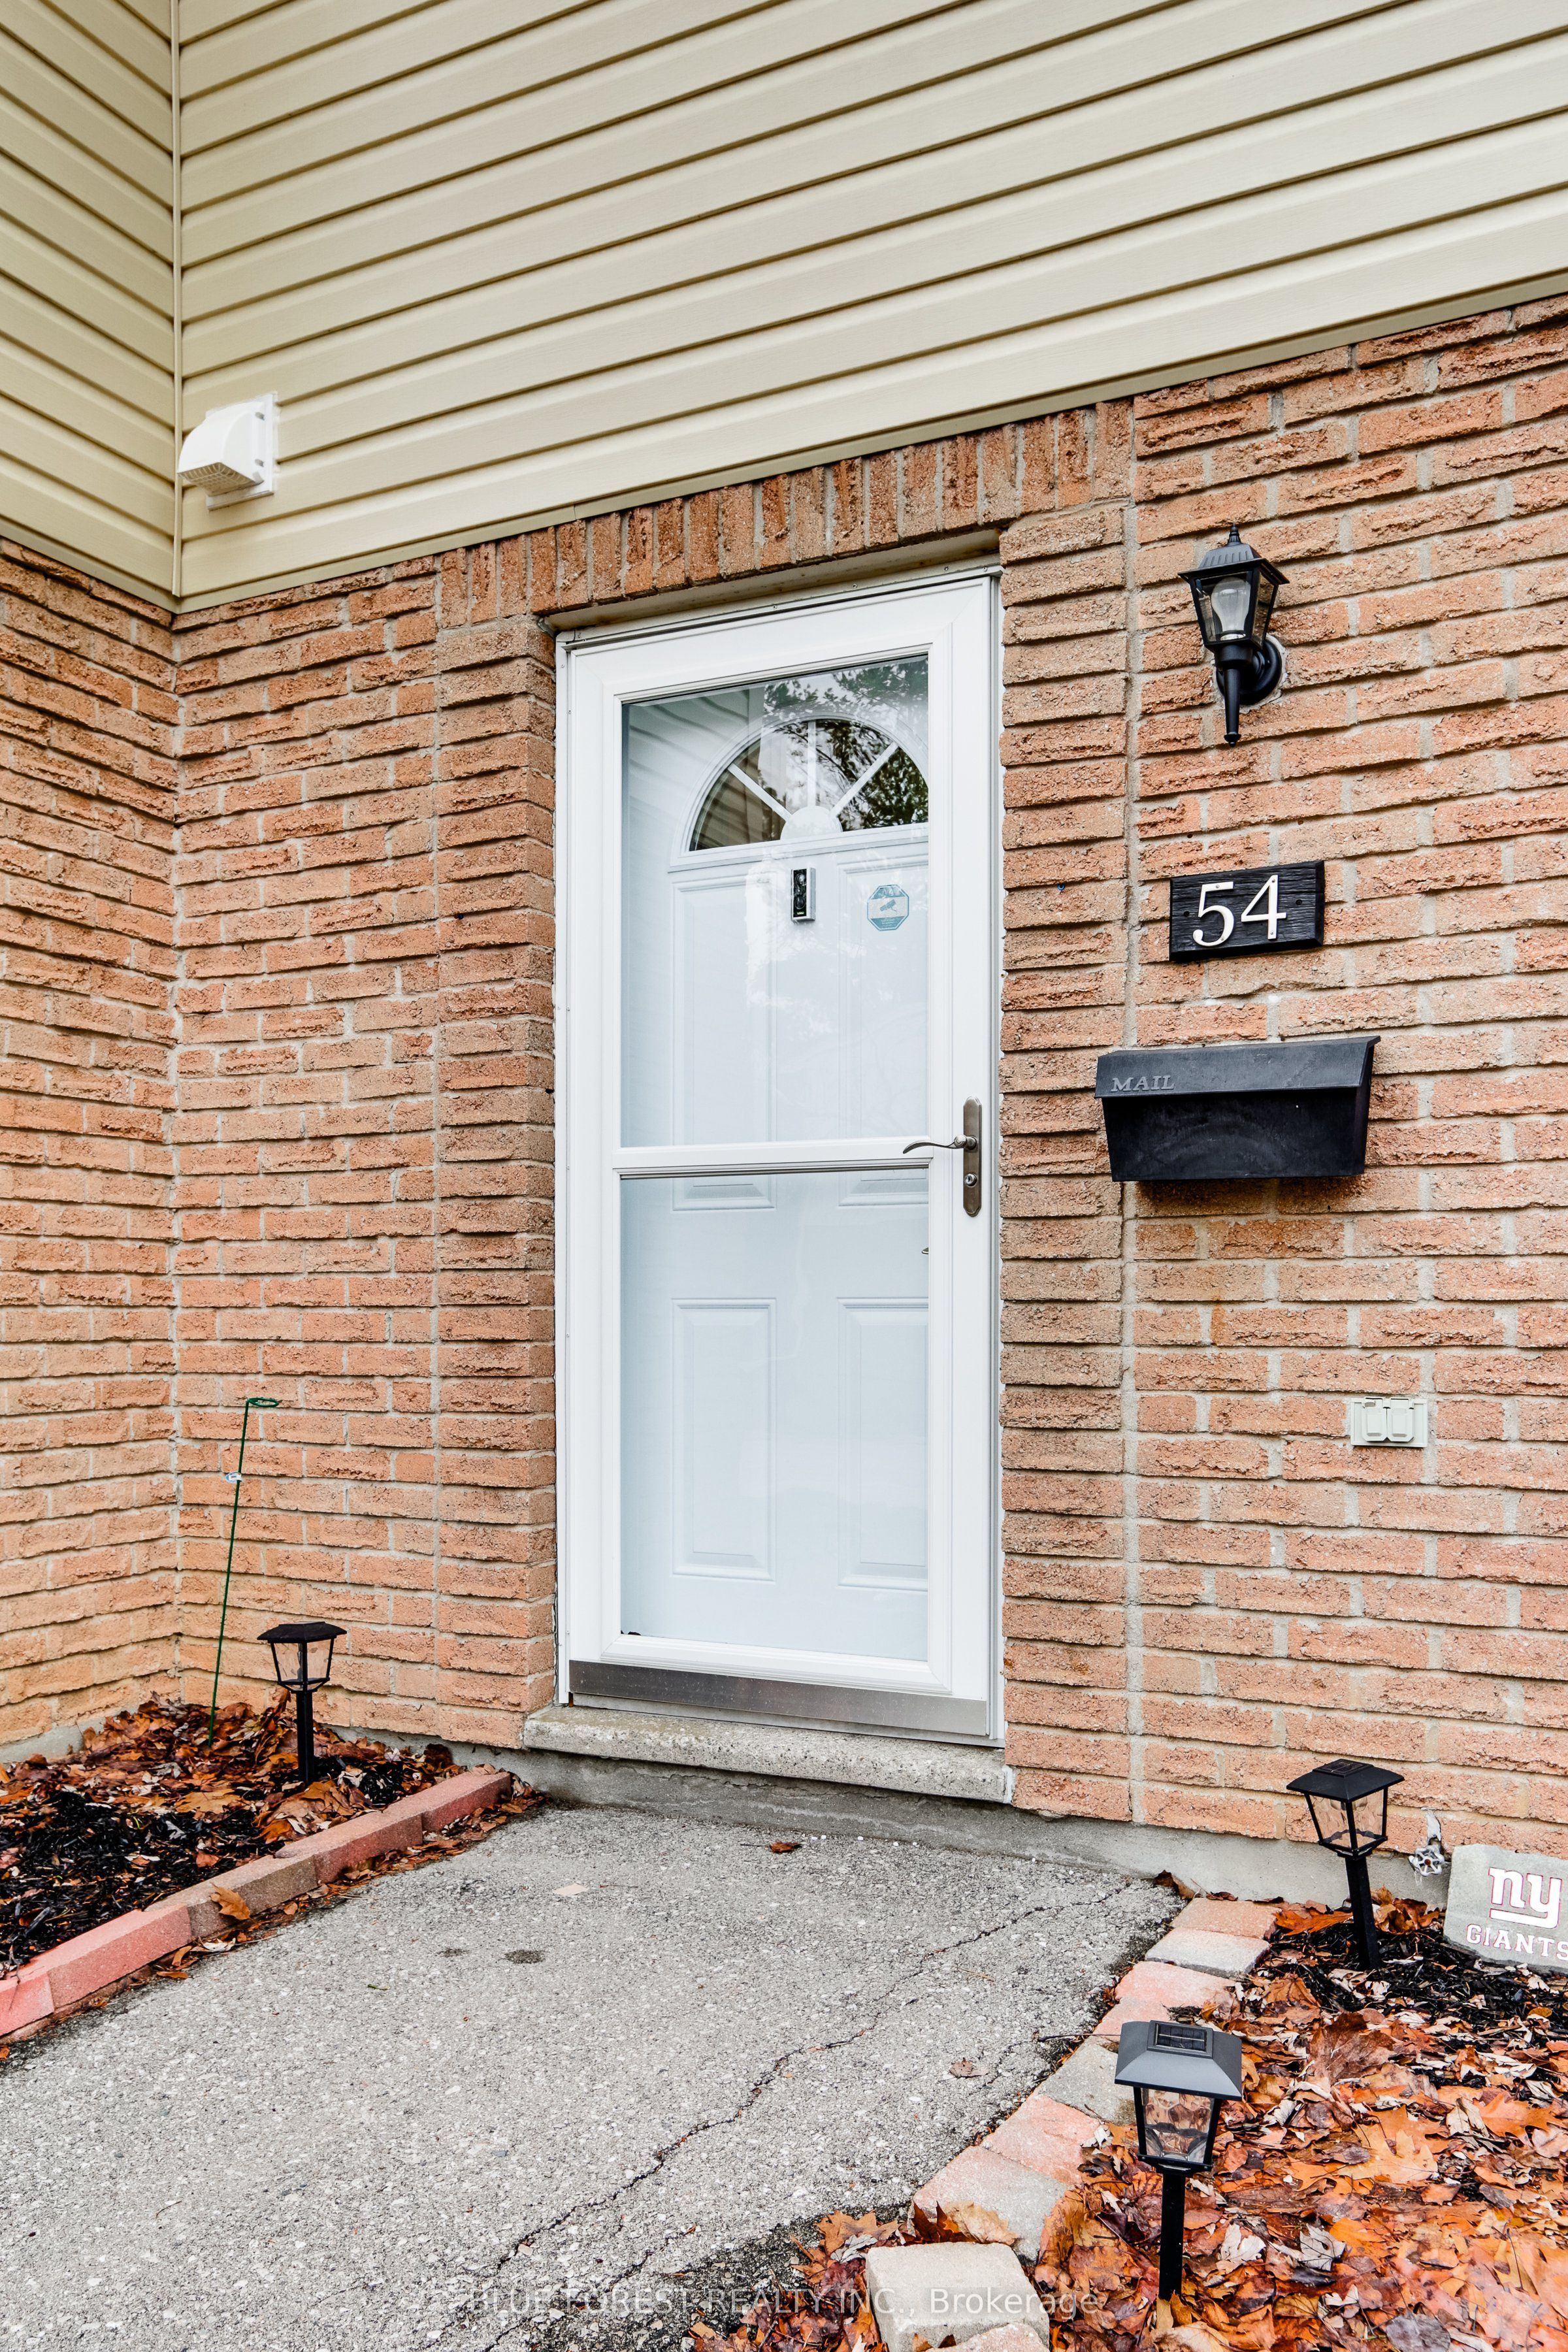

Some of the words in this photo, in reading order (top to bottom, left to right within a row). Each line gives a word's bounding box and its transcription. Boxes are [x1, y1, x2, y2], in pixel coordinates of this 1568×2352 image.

[1193, 874, 1287, 947] 54
[1111, 1075, 1175, 1092] MAIL
[1467, 1924, 1568, 1961] GIANTS
